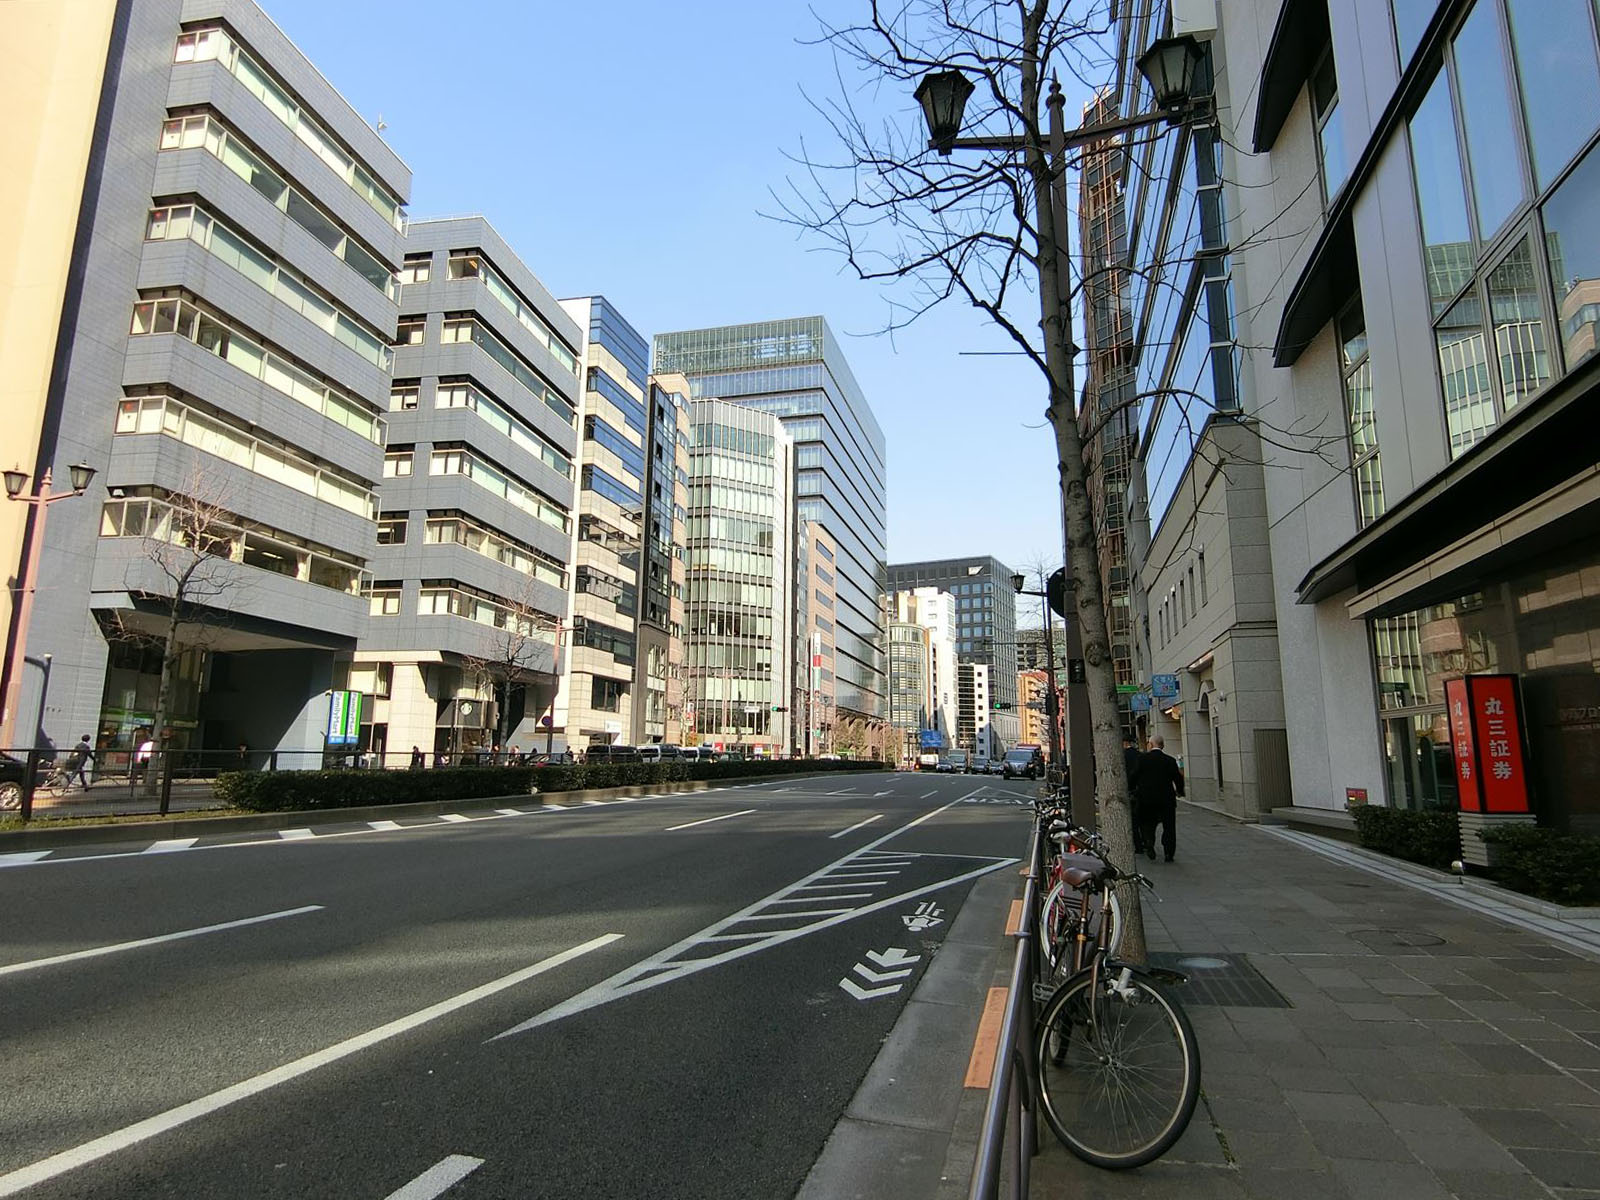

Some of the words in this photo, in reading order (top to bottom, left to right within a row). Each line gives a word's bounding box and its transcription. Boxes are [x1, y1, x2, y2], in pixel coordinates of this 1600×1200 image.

[1454, 699, 1470, 780] 丸三証券
[1485, 697, 1512, 780] 丸三証券
